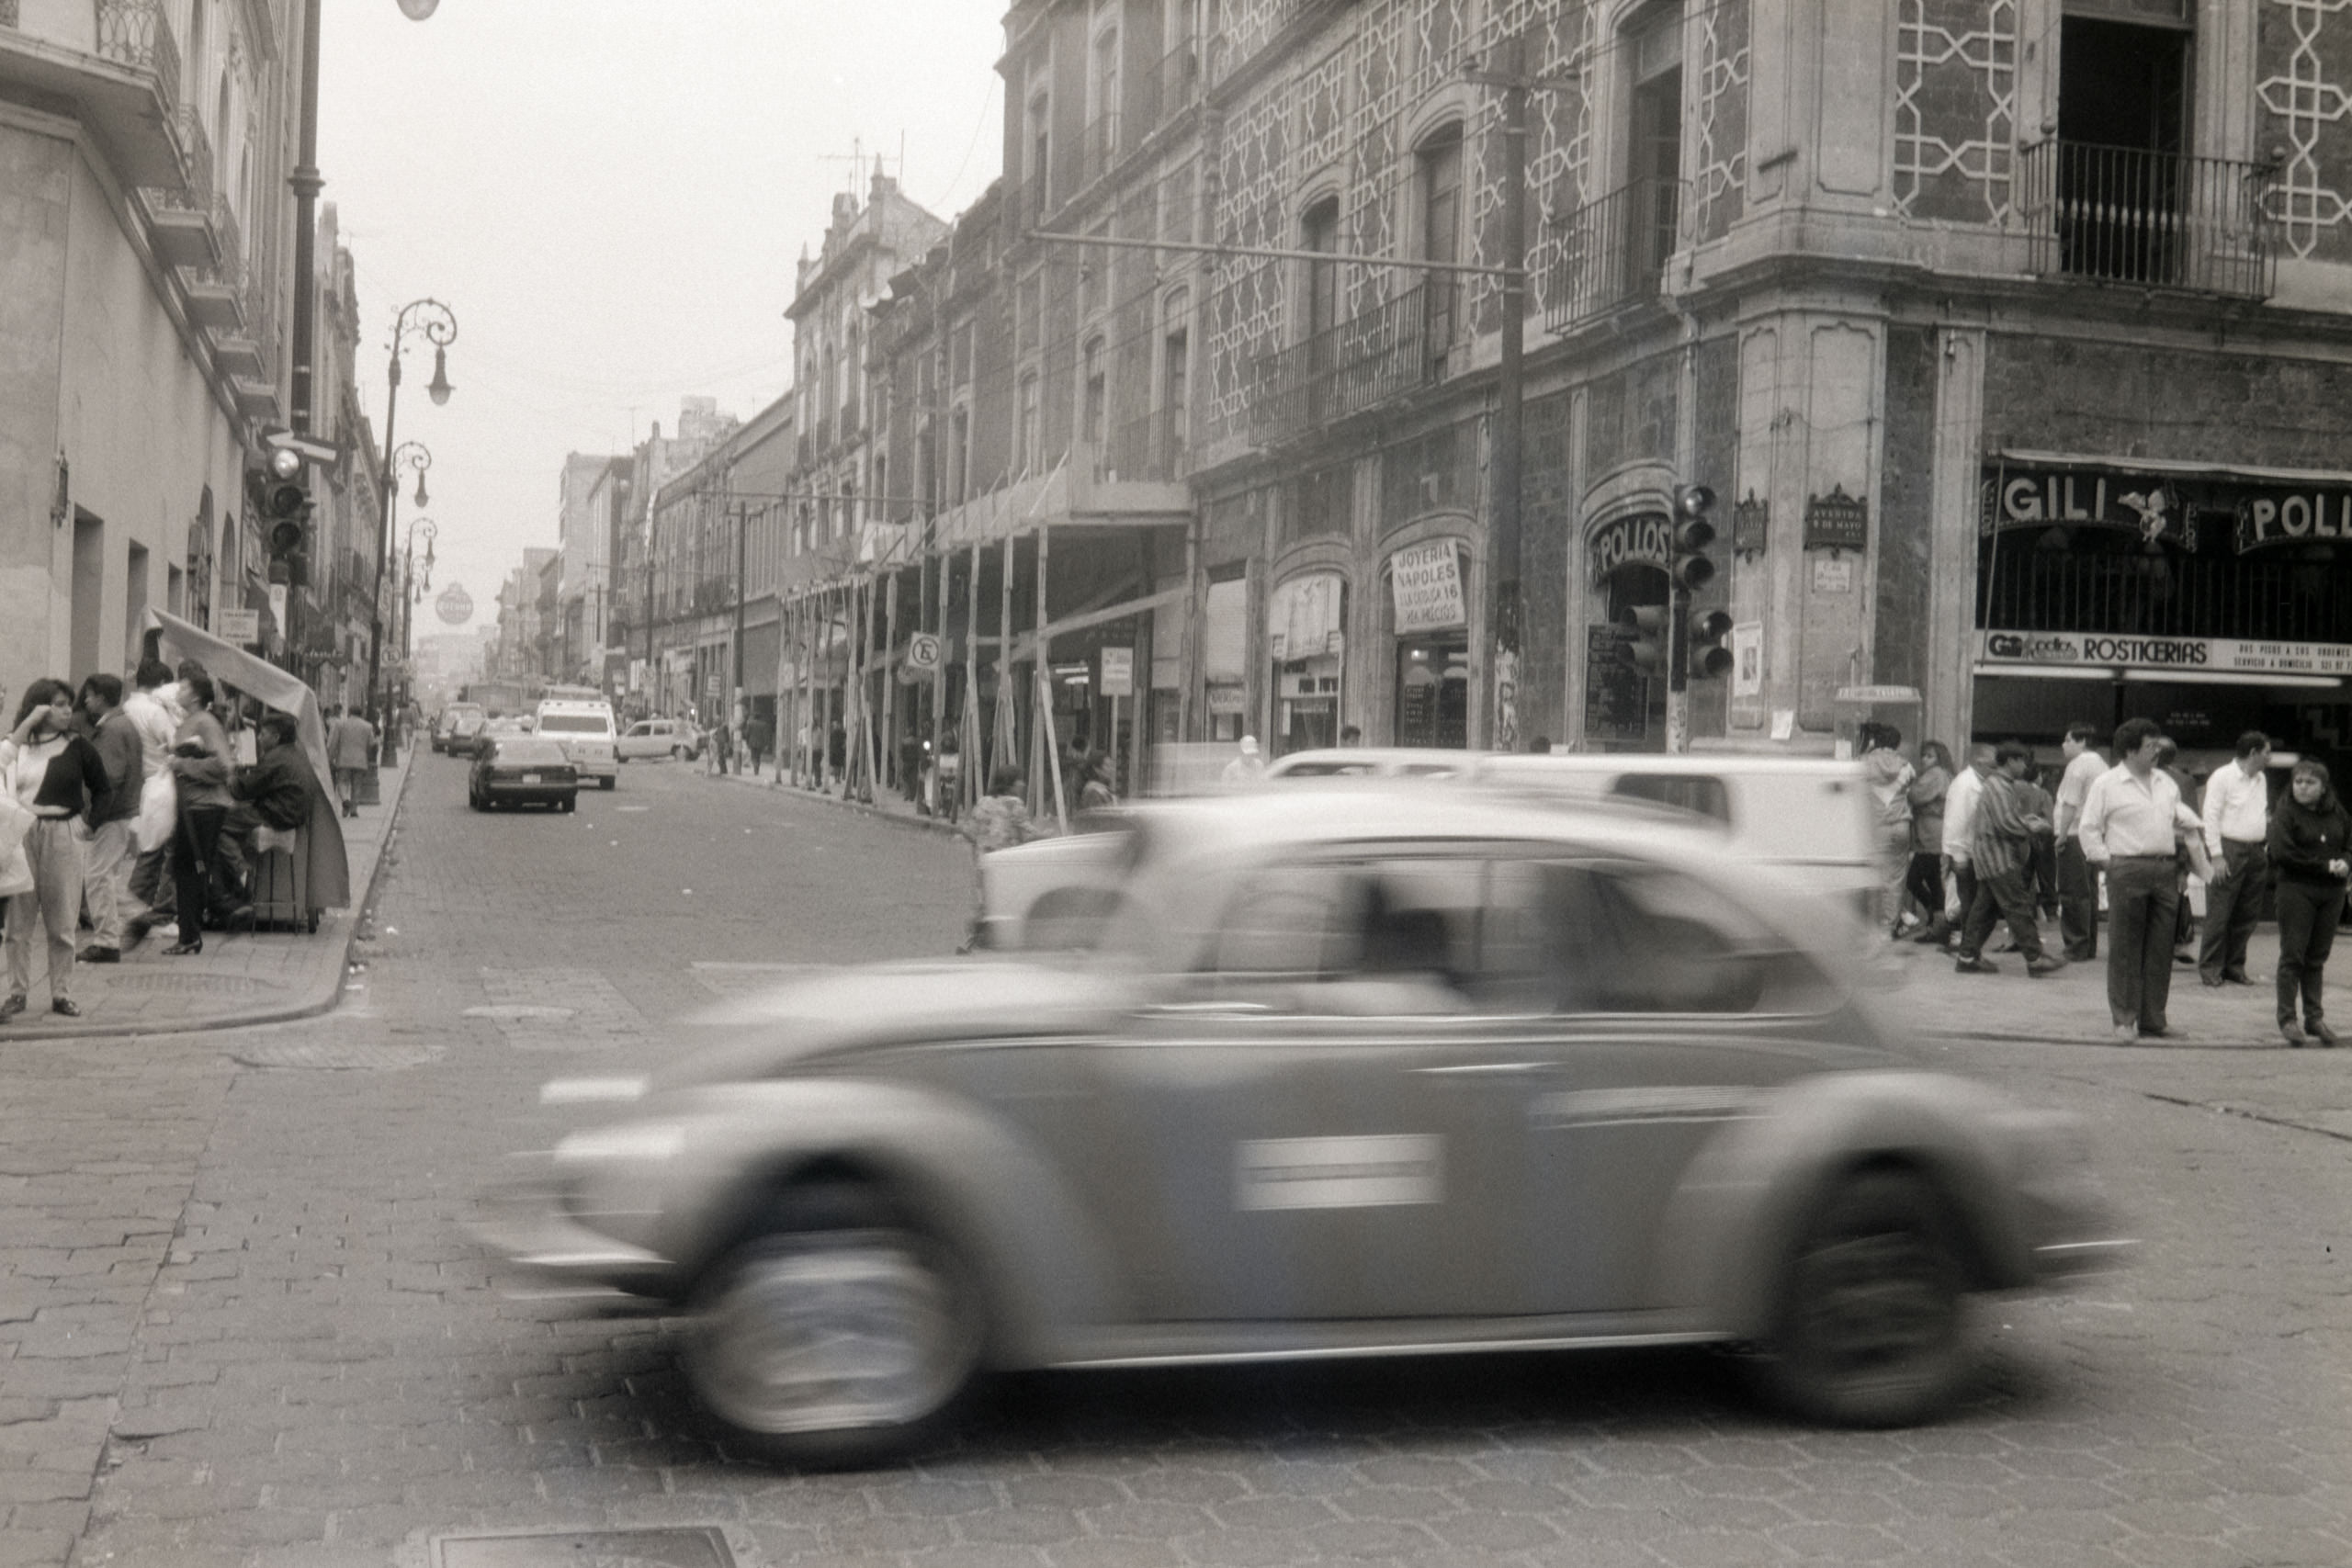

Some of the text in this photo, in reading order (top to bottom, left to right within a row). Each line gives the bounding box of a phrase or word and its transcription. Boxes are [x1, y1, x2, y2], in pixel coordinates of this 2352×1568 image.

[2004, 476, 2106, 521] GILI
[1813, 509, 1861, 520] AVENIDA
[1822, 520, 1833, 530] DE
[1836, 521, 1861, 530] MAYO
[1398, 543, 1452, 568] JOYERIA
[1600, 518, 1670, 572] POLLOS
[1444, 583, 1458, 600] 16
[2083, 637, 2208, 664] ROSTICERIAS
